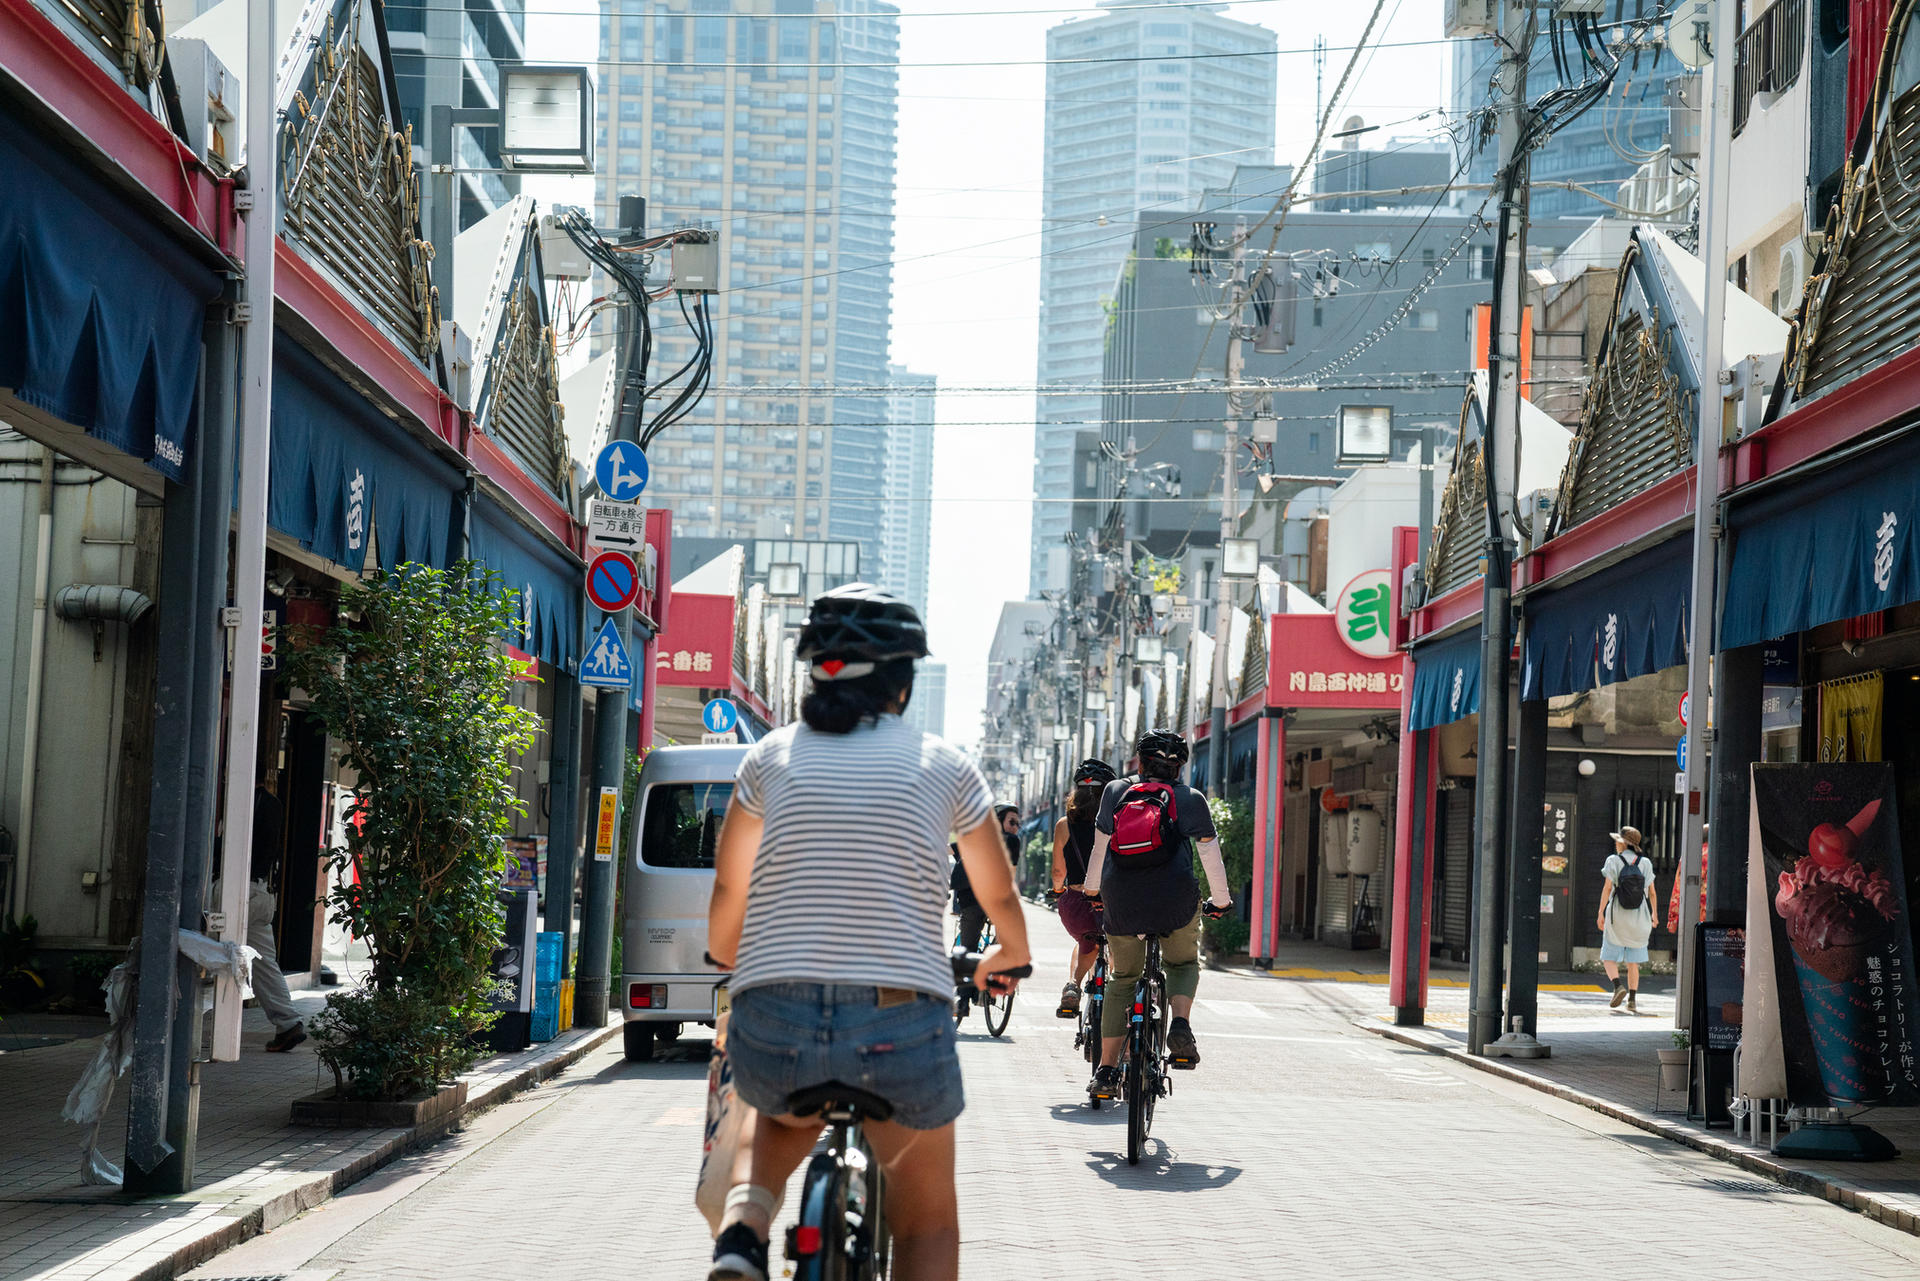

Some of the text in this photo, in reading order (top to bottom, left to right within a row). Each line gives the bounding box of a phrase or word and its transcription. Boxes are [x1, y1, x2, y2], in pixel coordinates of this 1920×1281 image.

[594, 504, 643, 520] 自転車を除く
[593, 520, 643, 534] 一方通行
[1289, 671, 1403, 692] 月島西仲通り
[1888, 943, 1918, 1088] ショコラトリーが作る、
[1866, 956, 1897, 1095] 魅惑のチョコクレープ
[1708, 1032, 1734, 1041] Brandy
